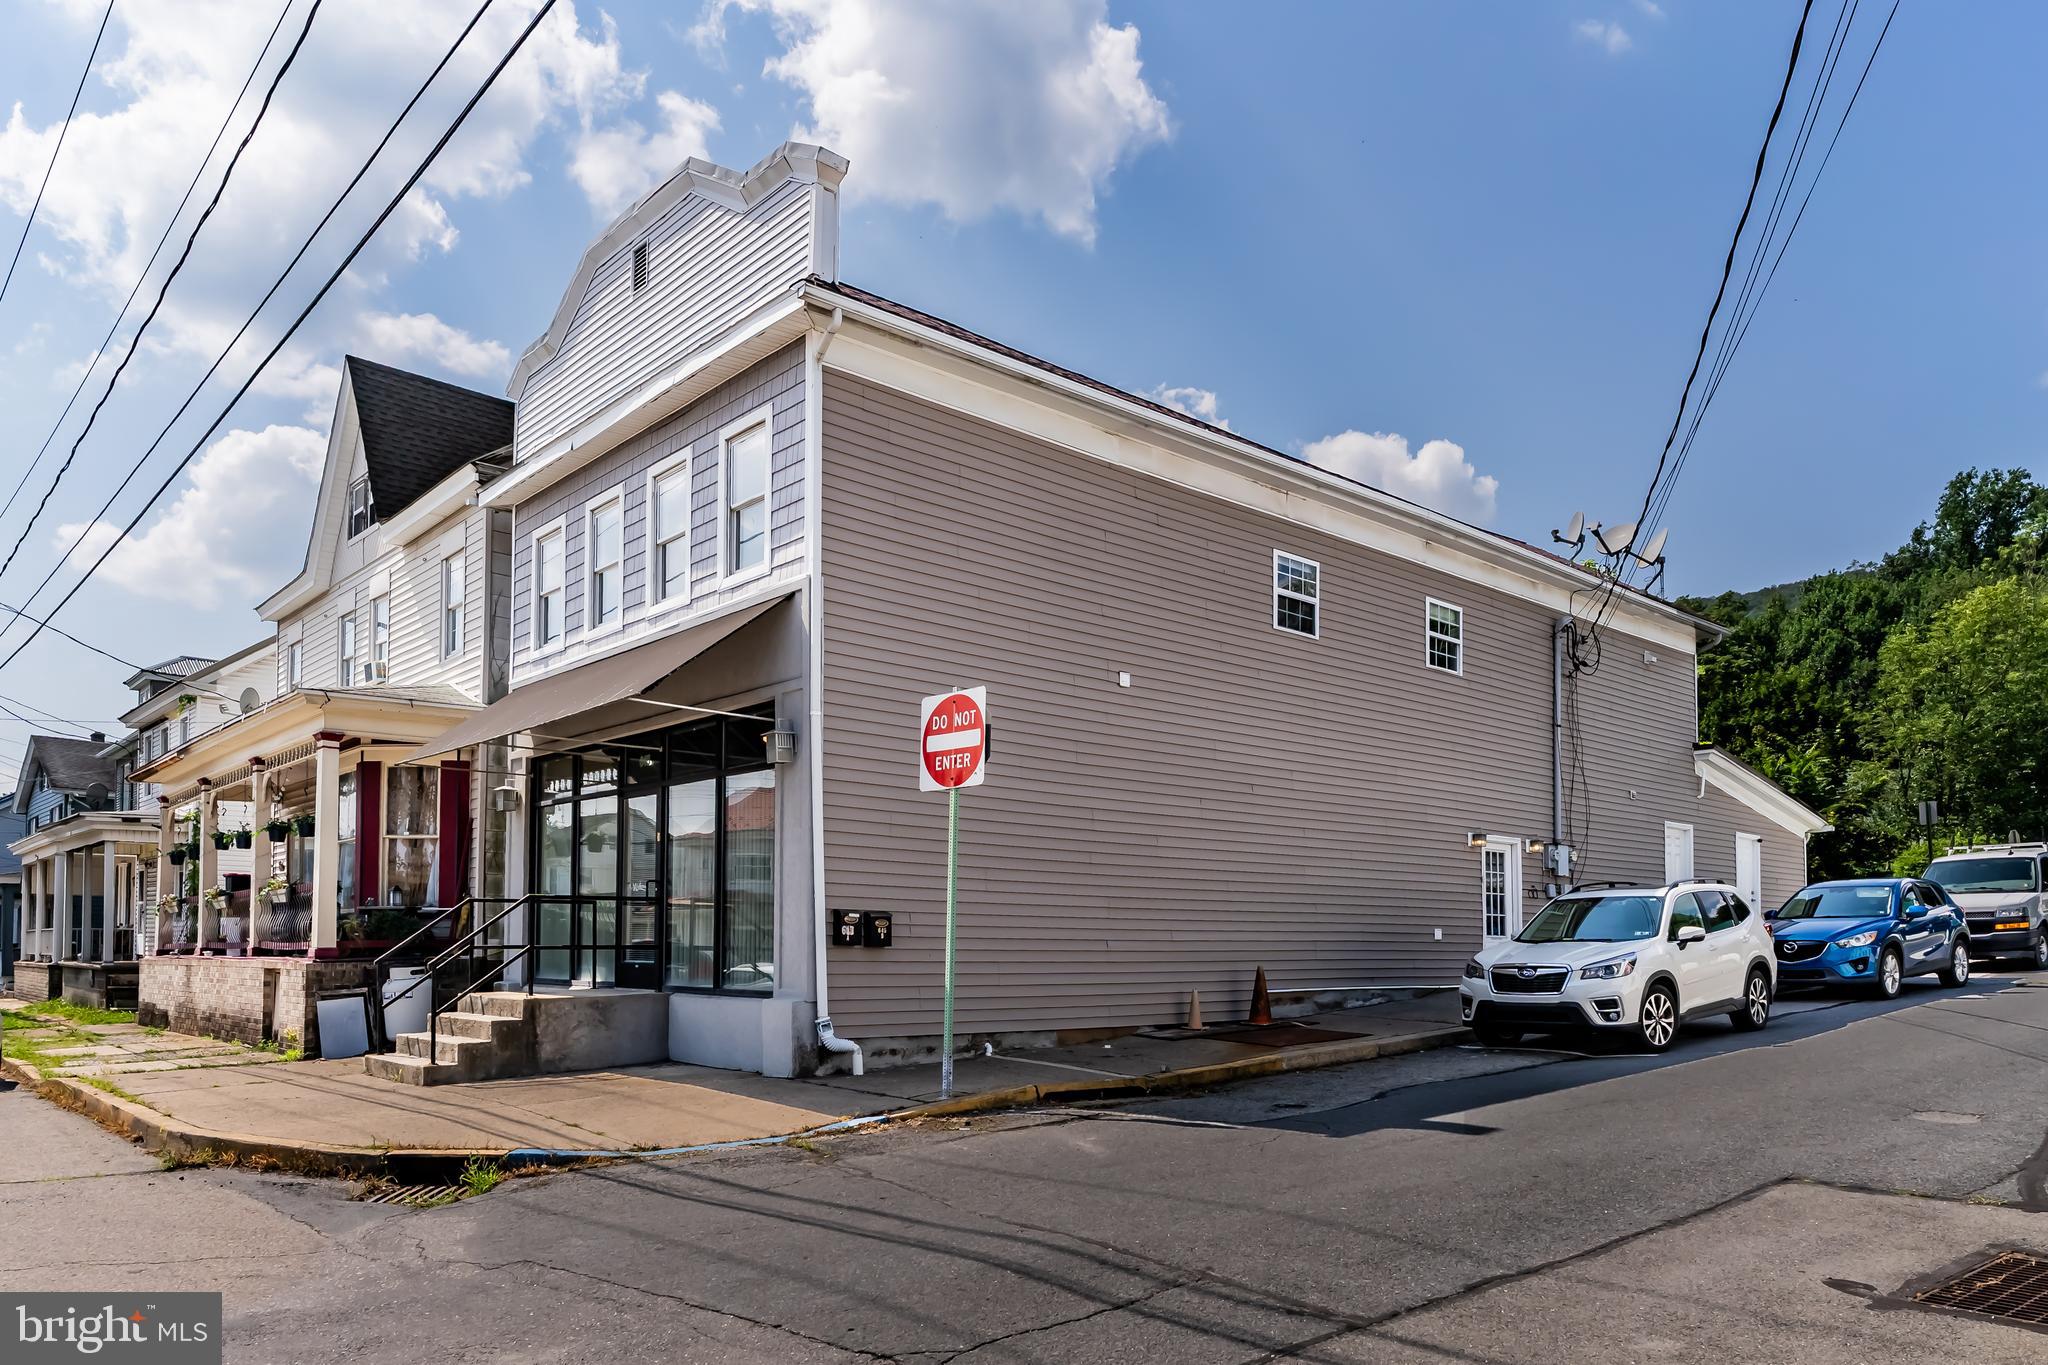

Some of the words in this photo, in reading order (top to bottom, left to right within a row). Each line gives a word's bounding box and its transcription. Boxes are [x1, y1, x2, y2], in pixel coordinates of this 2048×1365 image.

[932, 714, 948, 731] DO
[954, 709, 977, 727] NOT
[935, 752, 971, 771] ENTER
